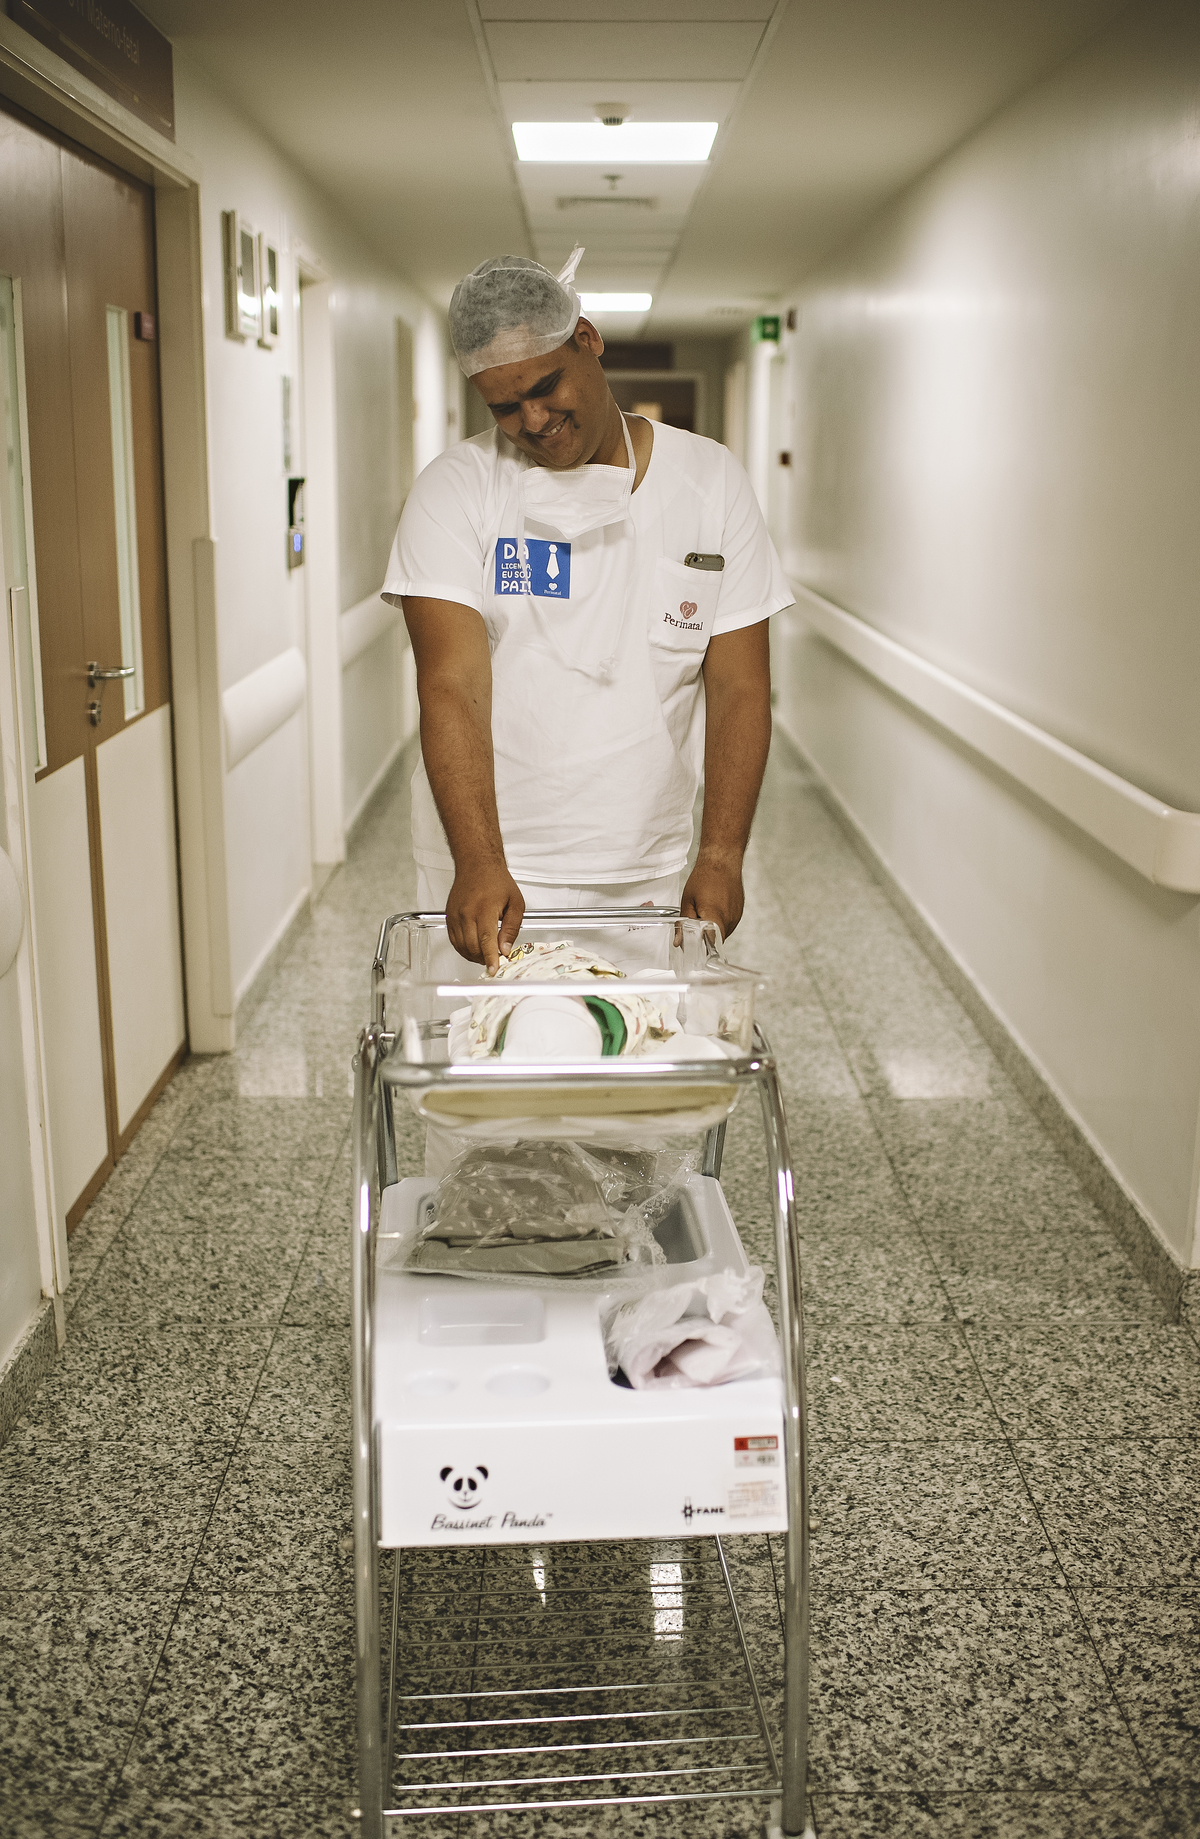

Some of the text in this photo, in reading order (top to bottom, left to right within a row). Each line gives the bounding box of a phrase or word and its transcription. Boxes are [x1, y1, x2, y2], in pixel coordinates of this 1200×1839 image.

[501, 562, 533, 571] LICENA,
[501, 571, 532, 579] EU SOU
[663, 612, 704, 631] Perinatal
[430, 1512, 497, 1531] Bassinet
